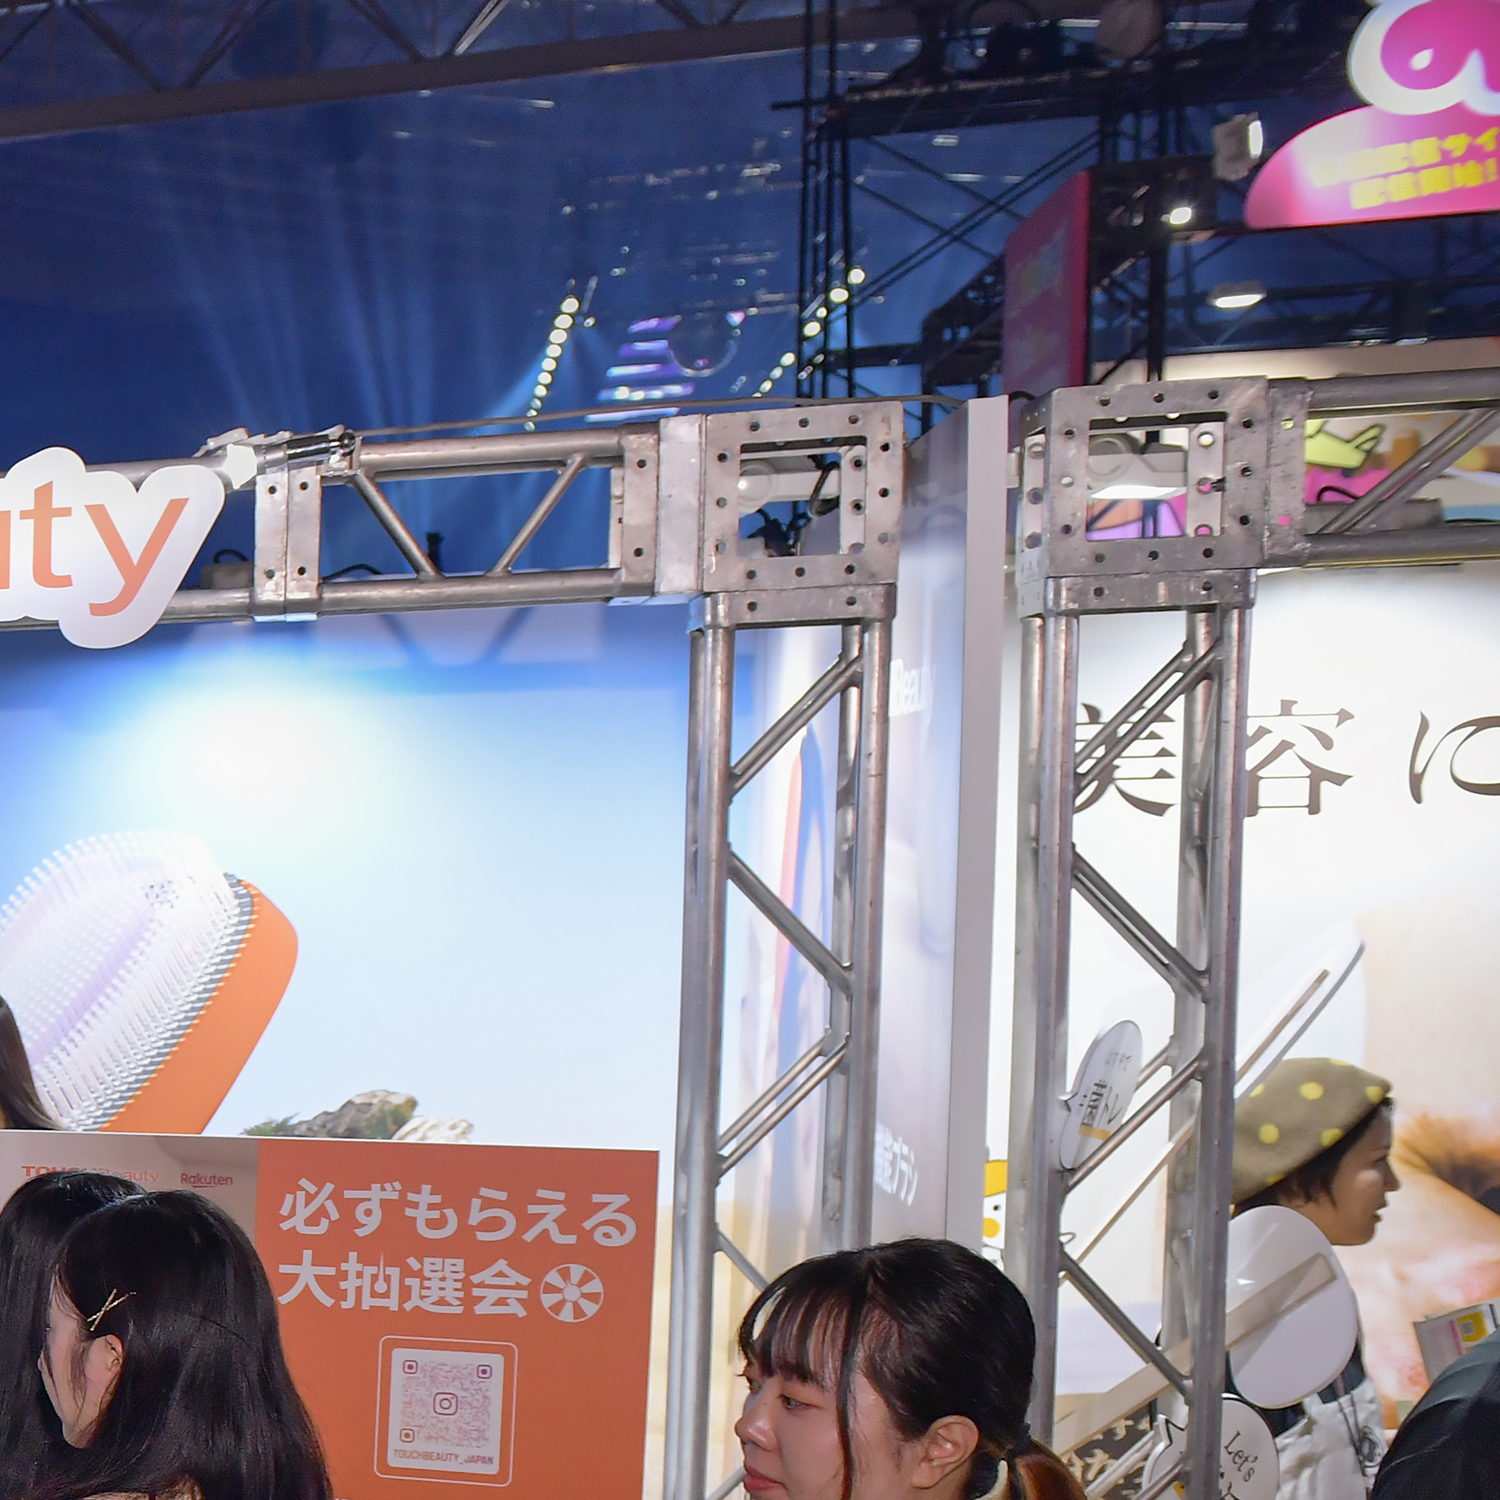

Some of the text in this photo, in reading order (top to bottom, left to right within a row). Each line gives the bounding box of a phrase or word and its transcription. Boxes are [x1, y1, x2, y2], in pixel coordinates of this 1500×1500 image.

[180, 1173, 233, 1187] Rakuten
[279, 1177, 638, 1247] 必ずもらえる
[277, 1250, 532, 1318] 大抽選会
[1224, 1430, 1259, 1483] Let's
